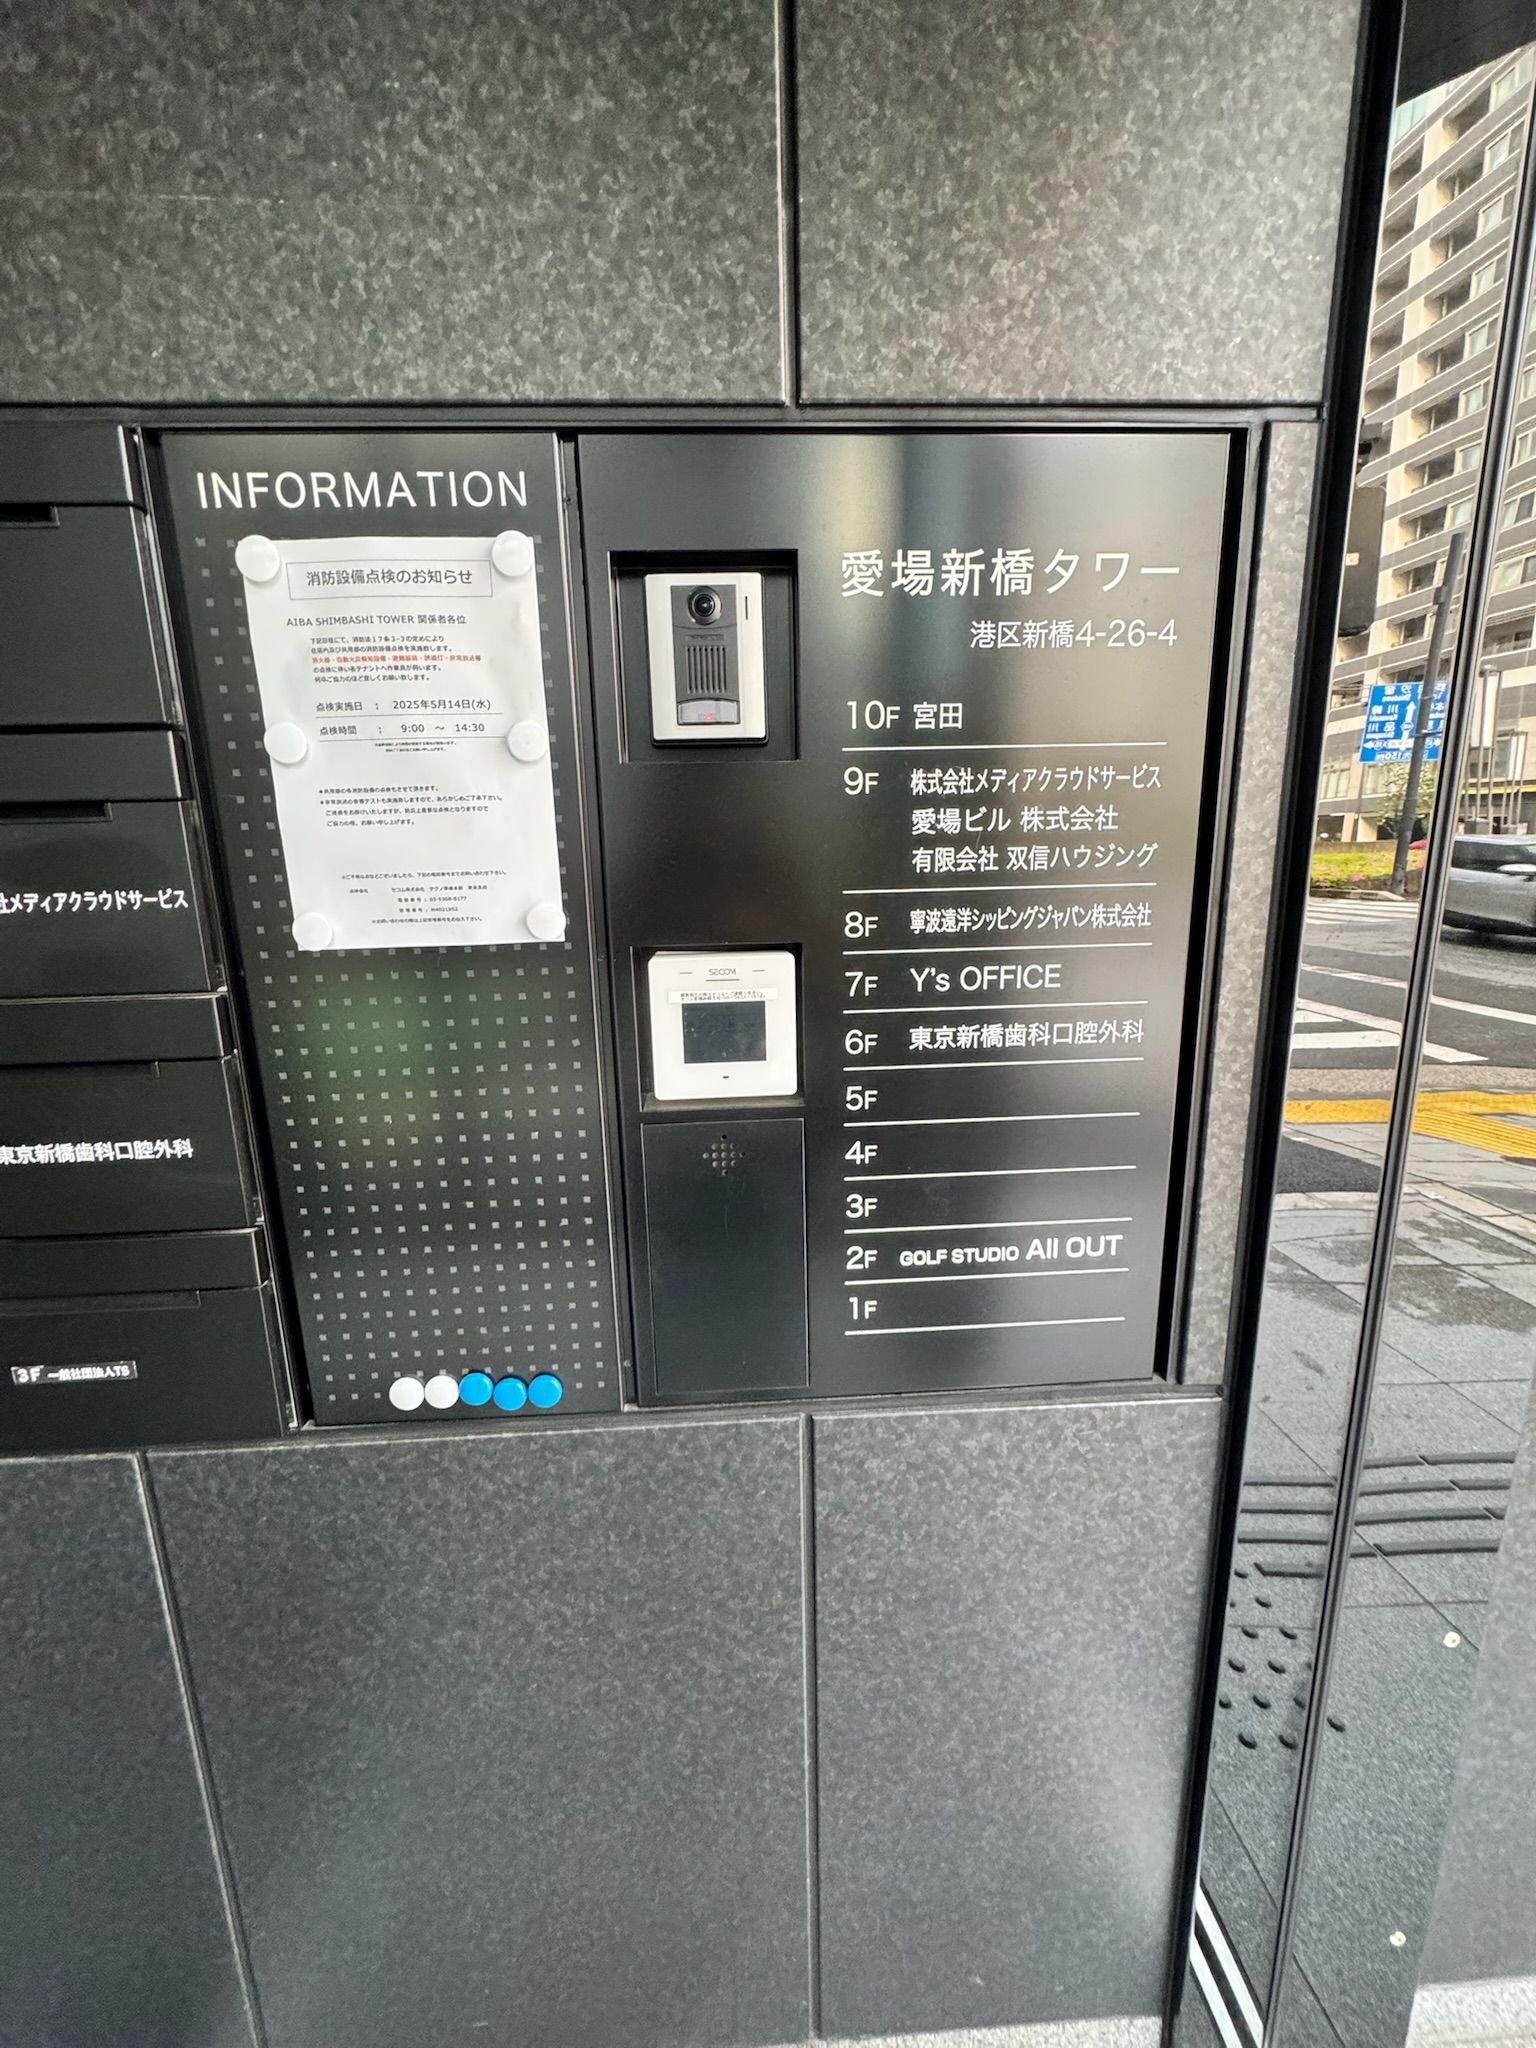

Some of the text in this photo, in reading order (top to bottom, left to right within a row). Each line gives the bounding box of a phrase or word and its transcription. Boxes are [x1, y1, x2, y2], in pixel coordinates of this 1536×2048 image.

[197, 470, 527, 509] INFORMATION
[306, 568, 472, 587] 消防設備点検のお知らせ
[841, 547, 1181, 598] 愛場新橋タワー
[286, 613, 467, 627] AIBA SHIMBASHI TOWER 関係者各位
[969, 619, 1178, 650] 港区新橋4-26-4
[316, 700, 363, 712] 点検実施日
[392, 698, 491, 711] 2025年5月14日(水)
[847, 700, 964, 730] 10F 宮田
[319, 725, 358, 736] 点検時間
[400, 724, 425, 734] 9:00
[455, 723, 486, 733] 14:30
[843, 763, 1162, 797] 9F 株式会社メディアクラウドサービス
[911, 804, 1119, 837] 愛場ビル 株式会社
[912, 843, 1159, 874] 有限会社 双信ハウジング
[844, 902, 1152, 939] 8F 寧波遠洋シッピングジャパン株式会社
[845, 963, 1062, 998] 7F Y's OFFICE
[844, 1018, 1144, 1055] 6F 東京新橋歯科口腔外科
[845, 1086, 878, 1111] 5F
[0, 1138, 194, 1166] 東京新橋歯科口腔外科
[844, 1141, 878, 1165] 4F
[845, 1193, 878, 1219] 3F
[846, 1245, 878, 1270] 2F
[899, 1249, 948, 1267] GOLF
[951, 1246, 1019, 1265] STUDIO
[1066, 1234, 1123, 1259] OUT
[849, 1297, 878, 1320] 1F
[18, 1368, 40, 1382] 3F
